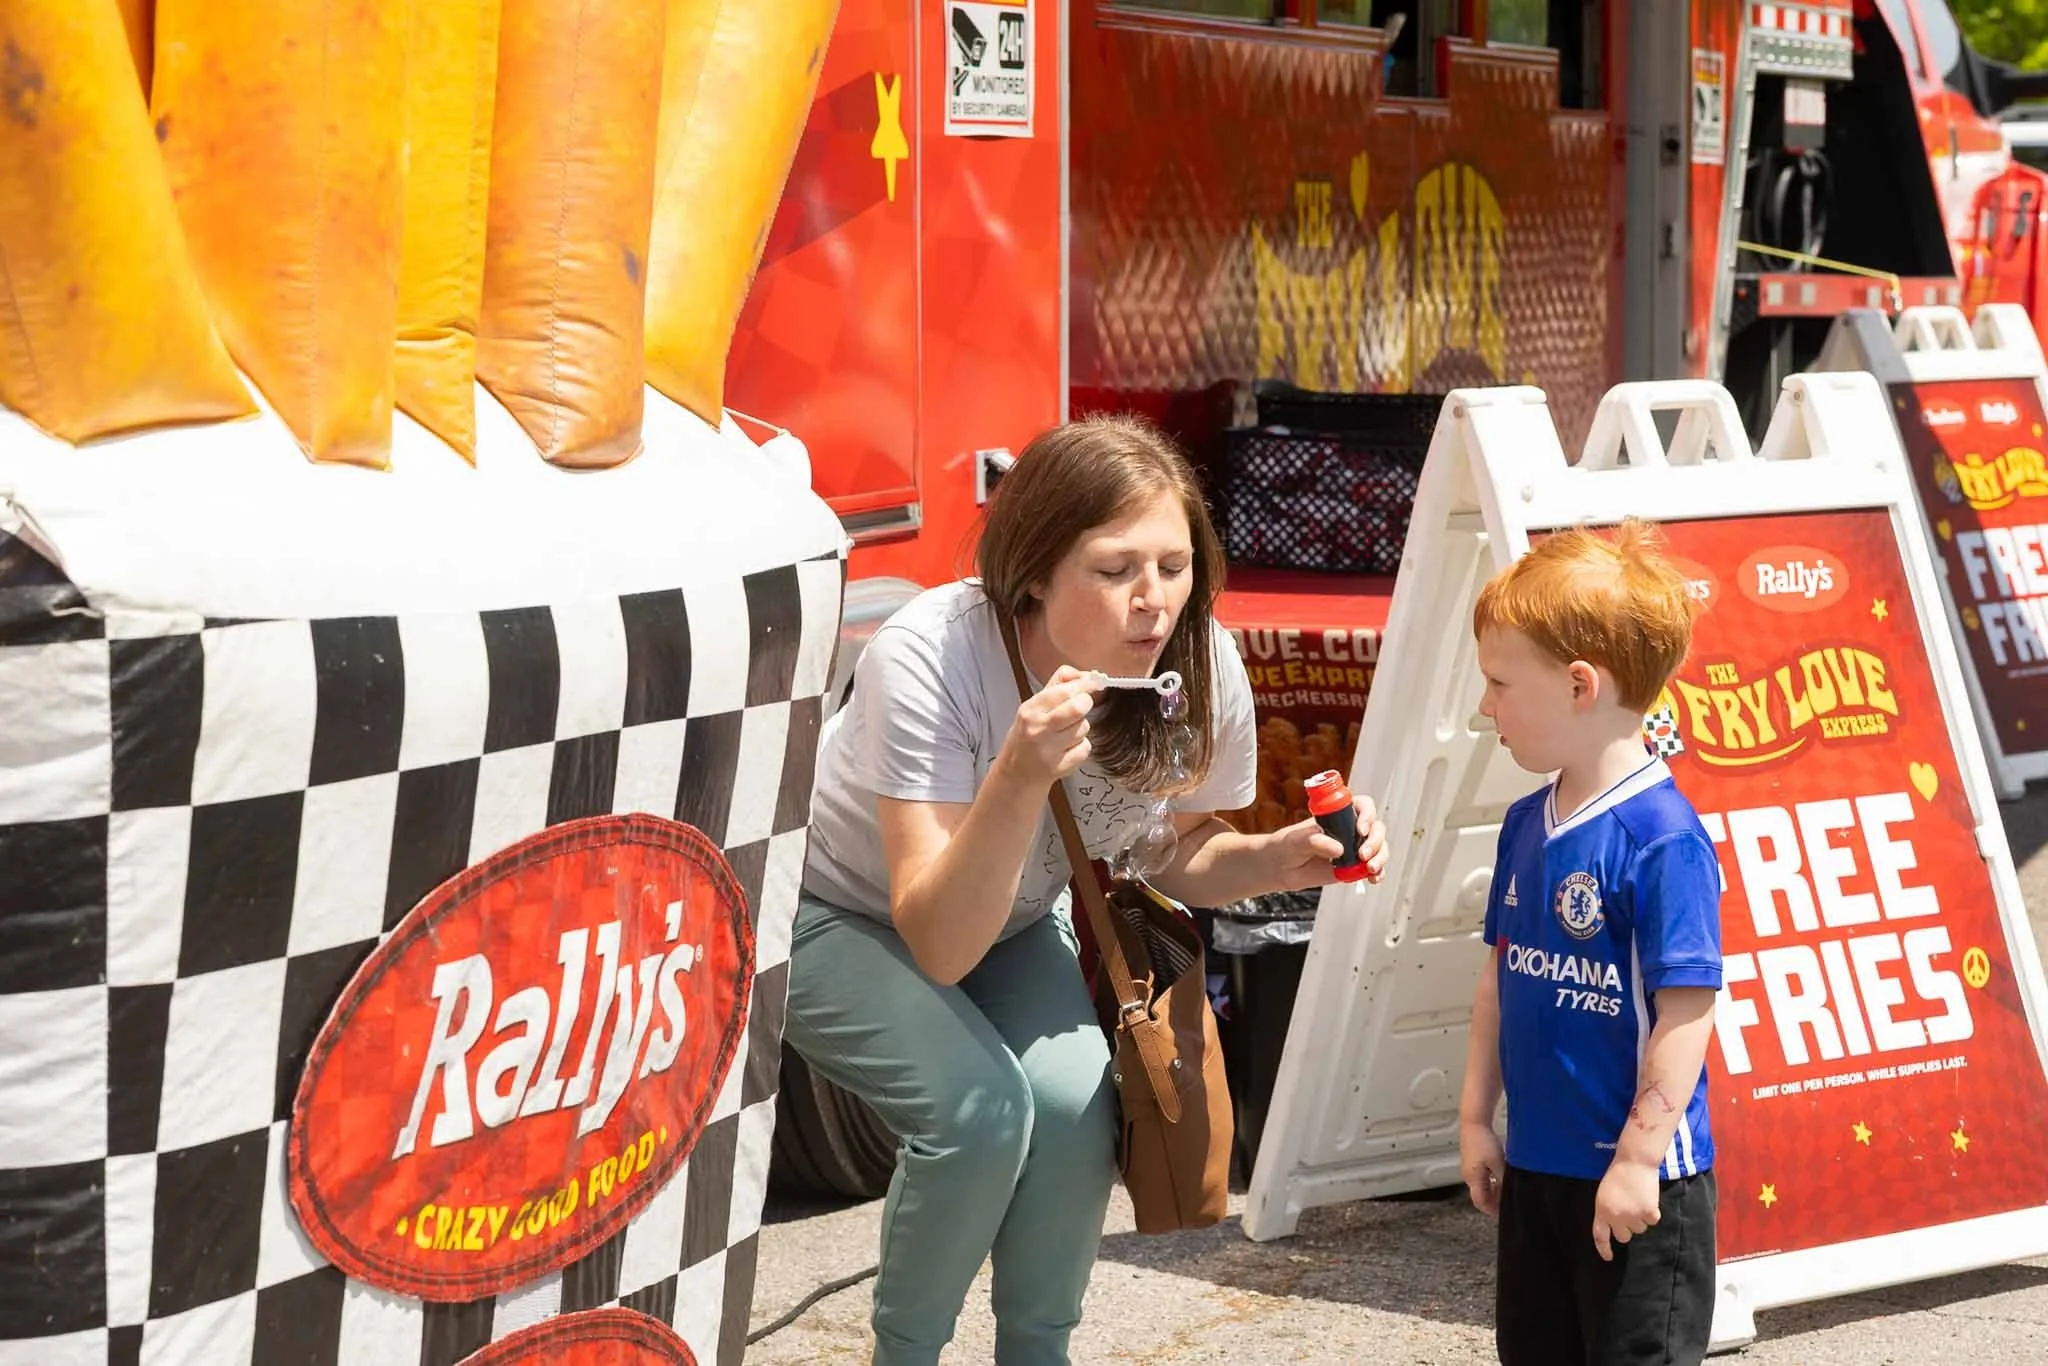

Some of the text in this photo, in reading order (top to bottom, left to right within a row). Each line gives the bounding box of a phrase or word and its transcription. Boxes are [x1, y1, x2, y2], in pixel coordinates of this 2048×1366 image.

[1295, 181, 1333, 248] THE
[1756, 560, 1834, 598] Rally's
[1675, 647, 1899, 749] FRY LOVE
[1705, 663, 1739, 686] THE
[1818, 713, 1889, 739] EXPRESS
[1507, 943, 1623, 992] OKOHAMA
[1555, 988, 1623, 1017] TYRES
[1713, 925, 1974, 1075] FRIES
[390, 901, 698, 1161] Rally's
[1752, 1084, 1779, 1100] LIMIT
[1780, 1080, 1802, 1096] ONE
[1803, 1077, 1824, 1092] PER
[1867, 1066, 1897, 1081] WHILE
[1898, 1059, 1942, 1077] SUPPLIES
[415, 1130, 655, 1251] CRAZY GOOD FOOD
